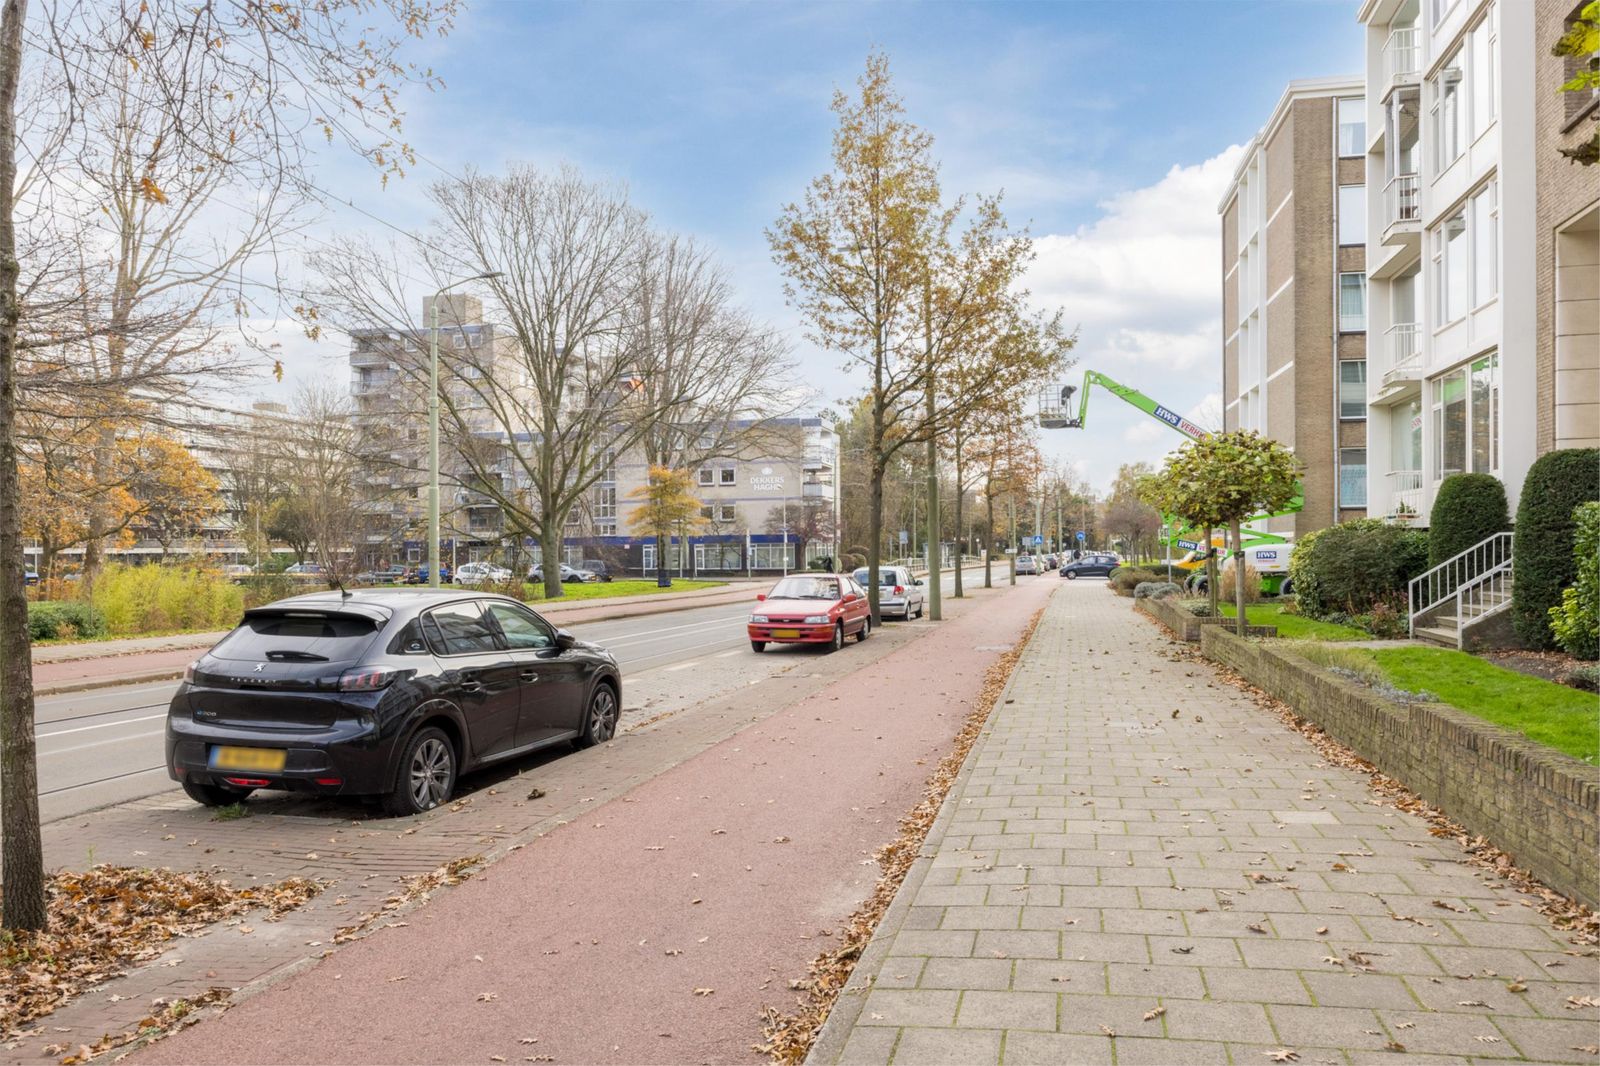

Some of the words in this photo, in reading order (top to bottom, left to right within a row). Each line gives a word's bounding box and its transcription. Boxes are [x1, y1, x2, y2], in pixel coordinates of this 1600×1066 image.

[1155, 407, 1178, 424] HWS
[1180, 420, 1206, 441] VERHU
[1178, 541, 1196, 550] HWS
